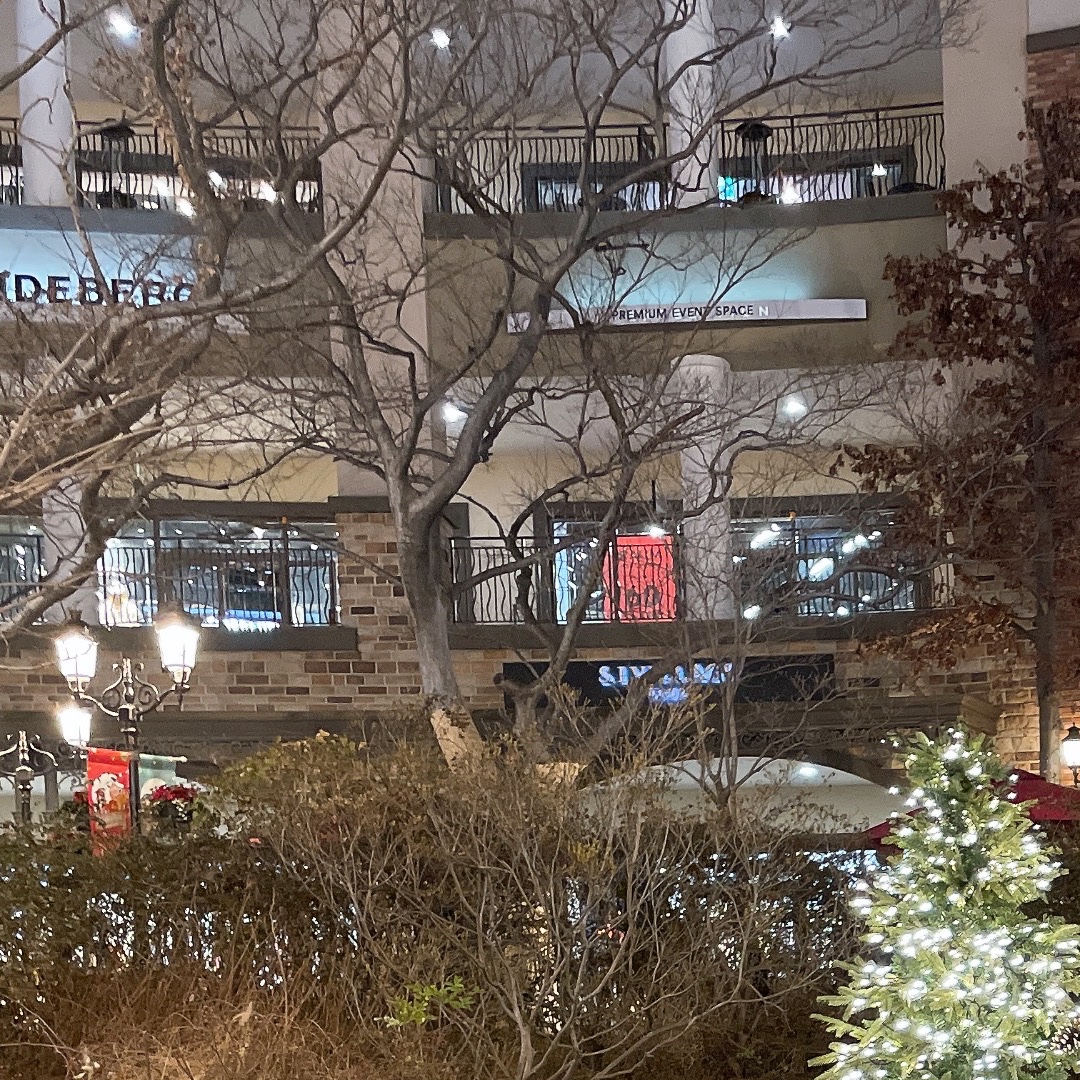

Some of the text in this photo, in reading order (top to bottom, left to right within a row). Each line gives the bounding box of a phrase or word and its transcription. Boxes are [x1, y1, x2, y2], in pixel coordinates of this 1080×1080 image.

[612, 307, 667, 321] PREMIUM
[672, 305, 711, 318] EVENT
[715, 304, 754, 317] SPACE
